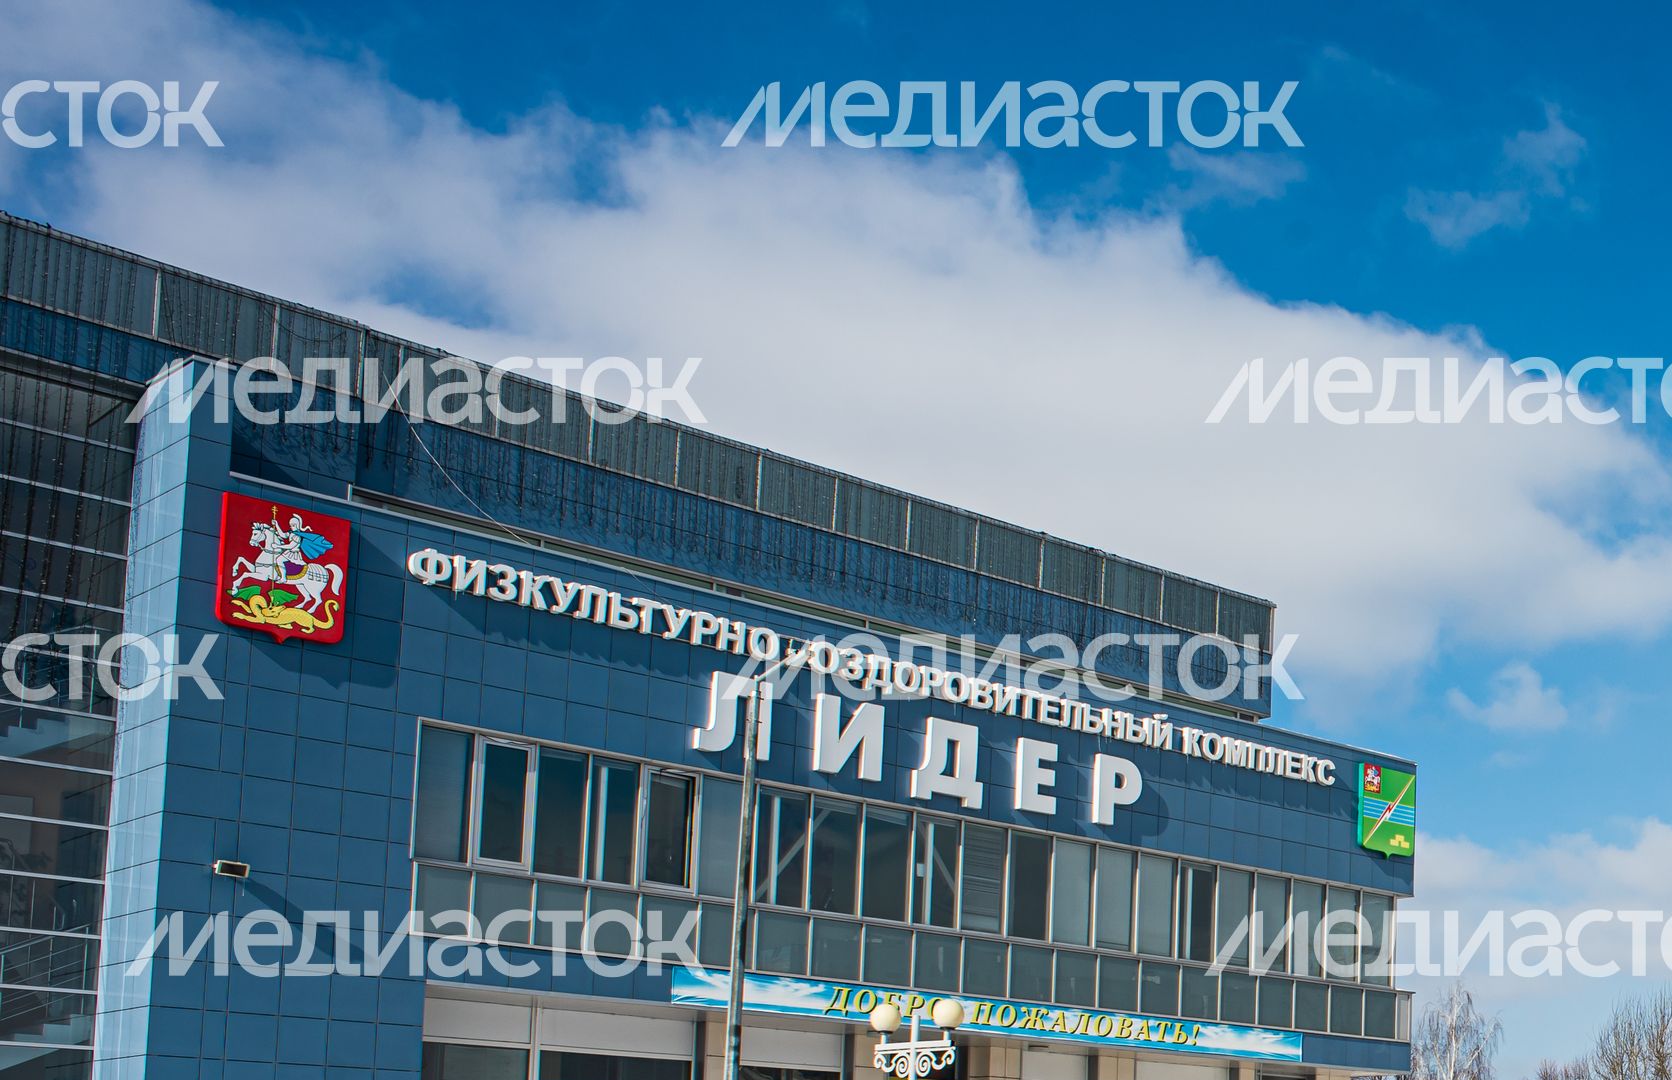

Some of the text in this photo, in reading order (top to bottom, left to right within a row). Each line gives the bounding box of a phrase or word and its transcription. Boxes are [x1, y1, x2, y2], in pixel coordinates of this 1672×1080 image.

[692, 669, 1143, 826] ЛИДЕР
[1181, 726, 1337, 787] КОМПЛЕКС
[969, 1000, 1201, 1047] ПОЖАЛОВАТЬ!
